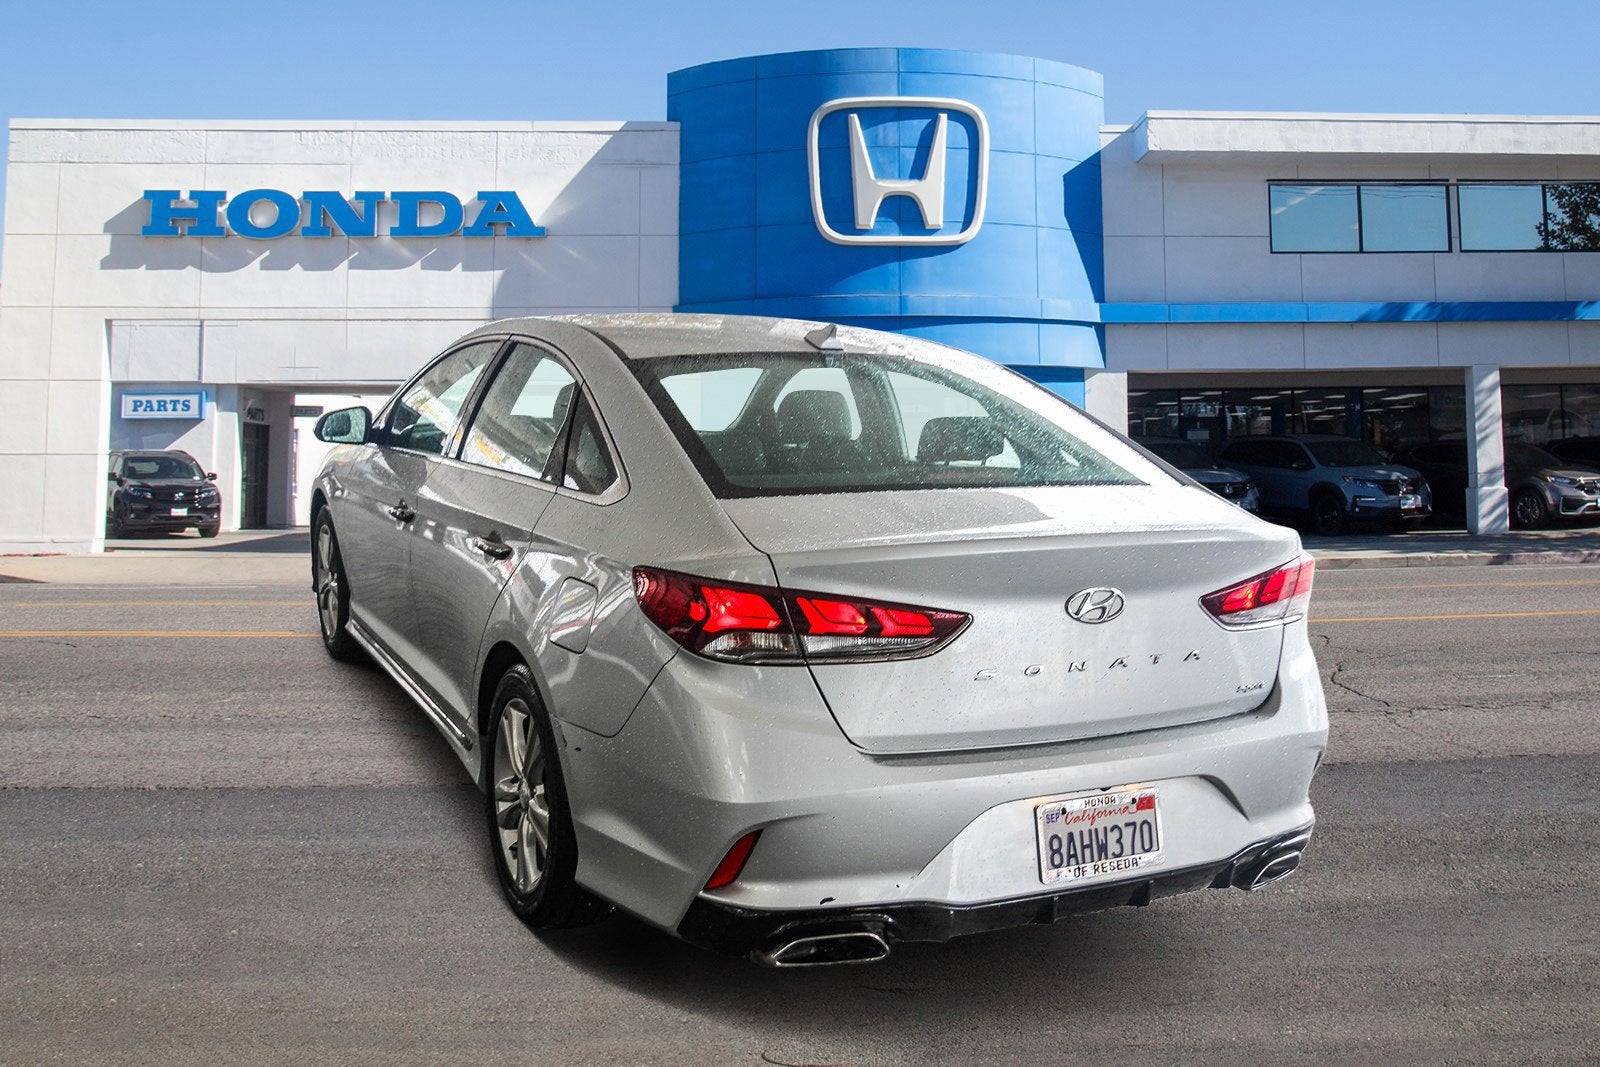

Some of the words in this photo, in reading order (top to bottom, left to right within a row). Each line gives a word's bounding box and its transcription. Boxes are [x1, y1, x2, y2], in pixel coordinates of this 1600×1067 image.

[141, 188, 547, 239] HONDA
[131, 399, 192, 413] PARTS
[973, 649, 1201, 682] SONATA
[1084, 795, 1117, 808] HONDA
[1045, 812, 1061, 824] SEP
[1064, 805, 1136, 826] California
[1048, 819, 1153, 869] 8AHW370
[1073, 866, 1088, 878] OF
[1093, 857, 1139, 874] RESEDA
